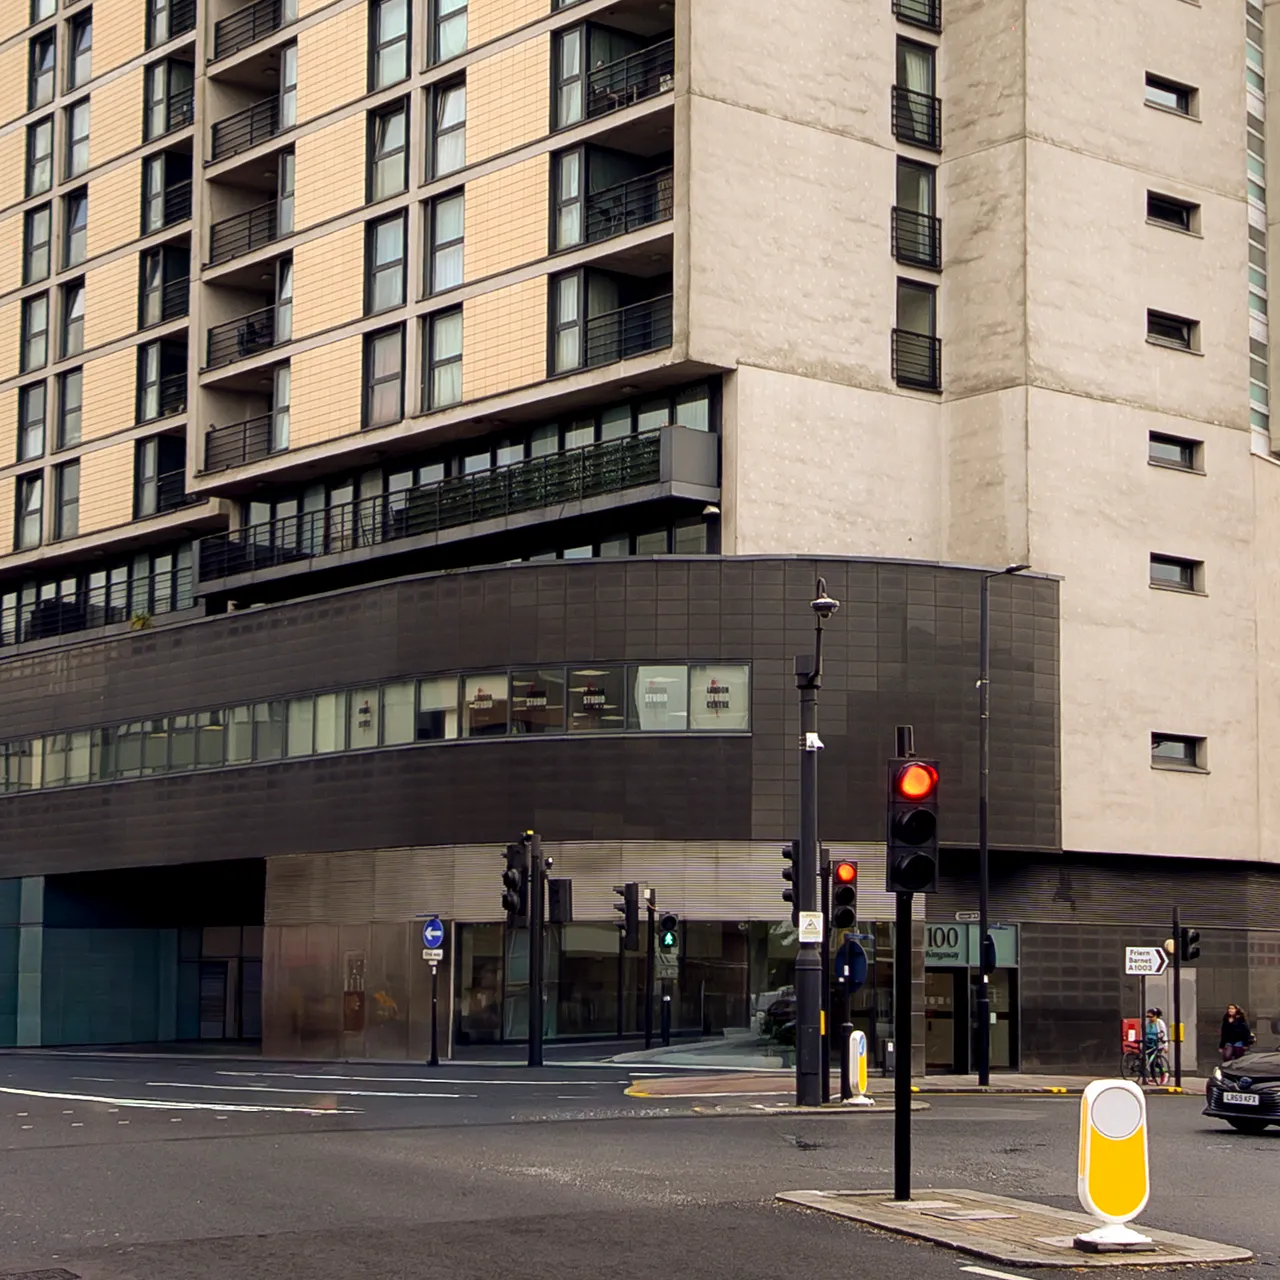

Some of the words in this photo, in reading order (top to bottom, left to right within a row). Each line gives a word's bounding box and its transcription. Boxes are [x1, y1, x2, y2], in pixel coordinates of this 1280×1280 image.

[583, 695, 605, 704] STUDIO
[926, 927, 959, 948] 100
[925, 950, 960, 960] Kingsway
